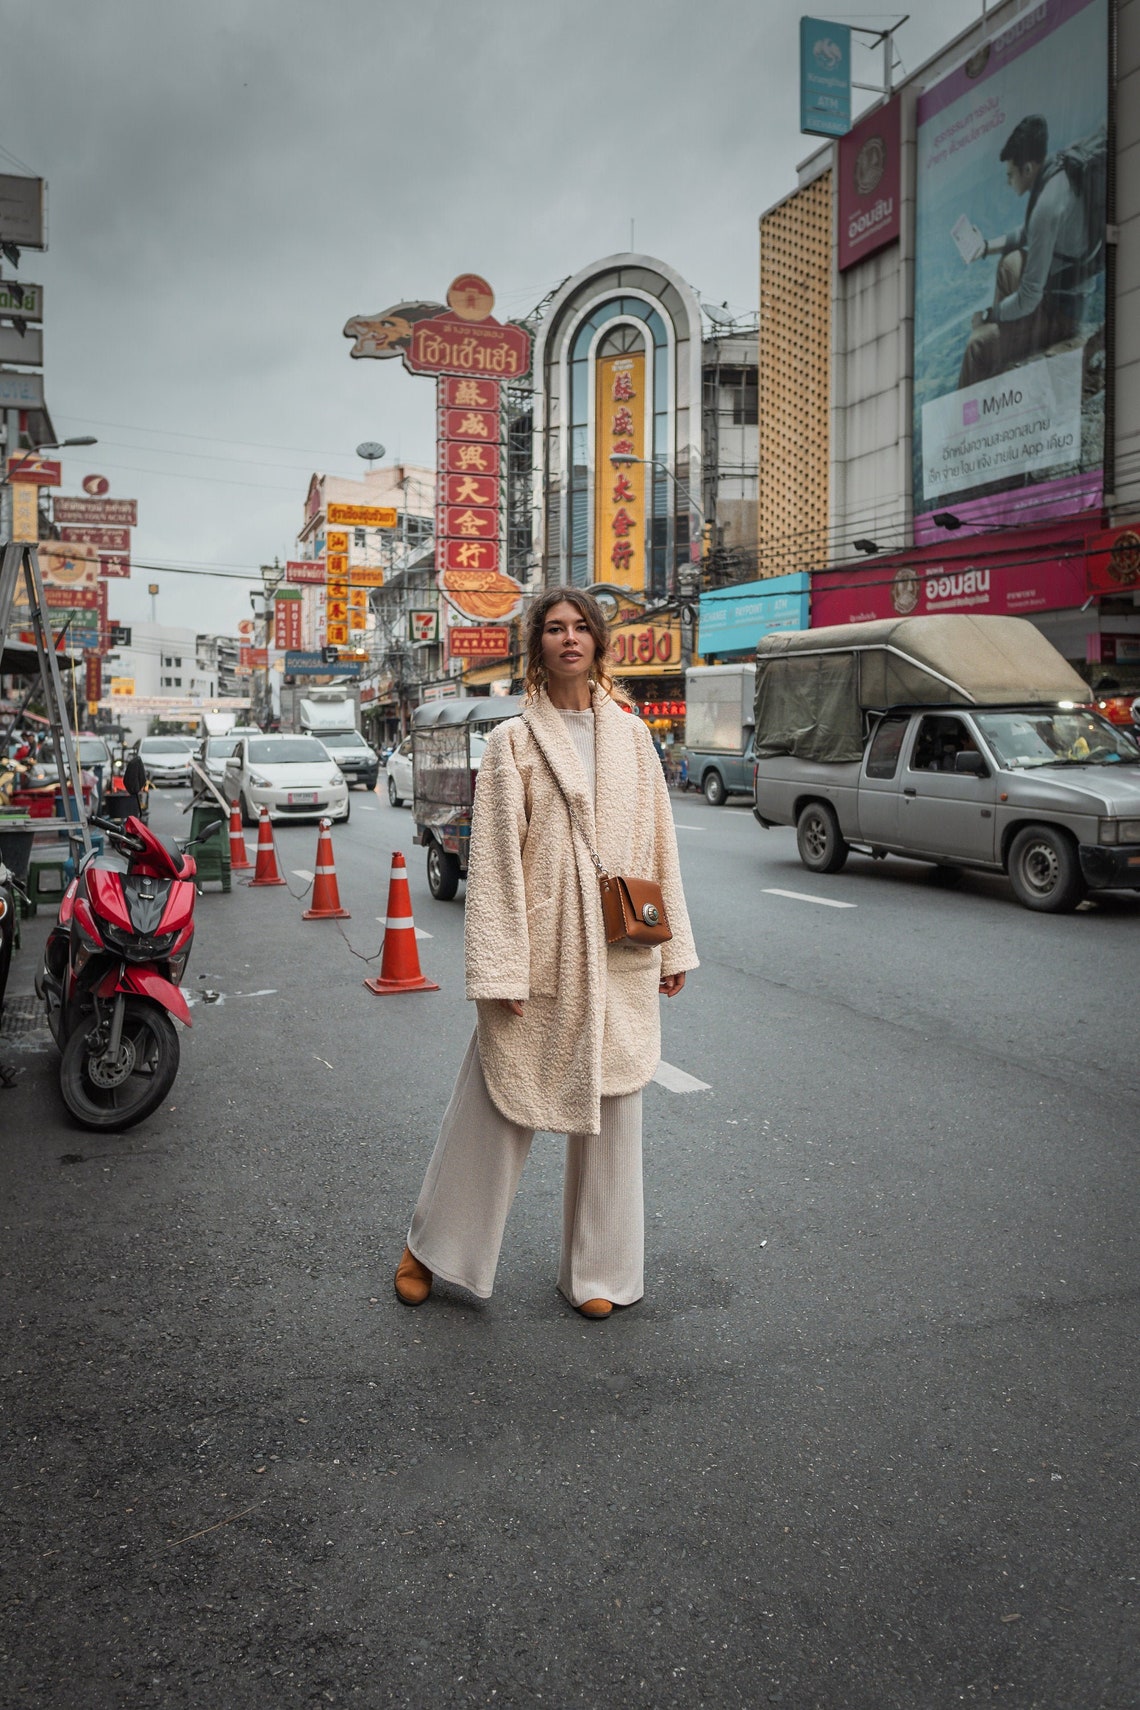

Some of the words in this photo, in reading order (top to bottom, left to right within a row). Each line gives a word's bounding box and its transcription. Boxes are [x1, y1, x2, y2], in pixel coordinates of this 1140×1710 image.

[848, 197, 893, 238] ออมสิน
[983, 389, 1023, 415] MyMo
[1022, 443, 1044, 457] App
[926, 565, 990, 599] ออมสิน
[774, 599, 788, 610] ATM
[291, 603, 299, 647] HOTEL
